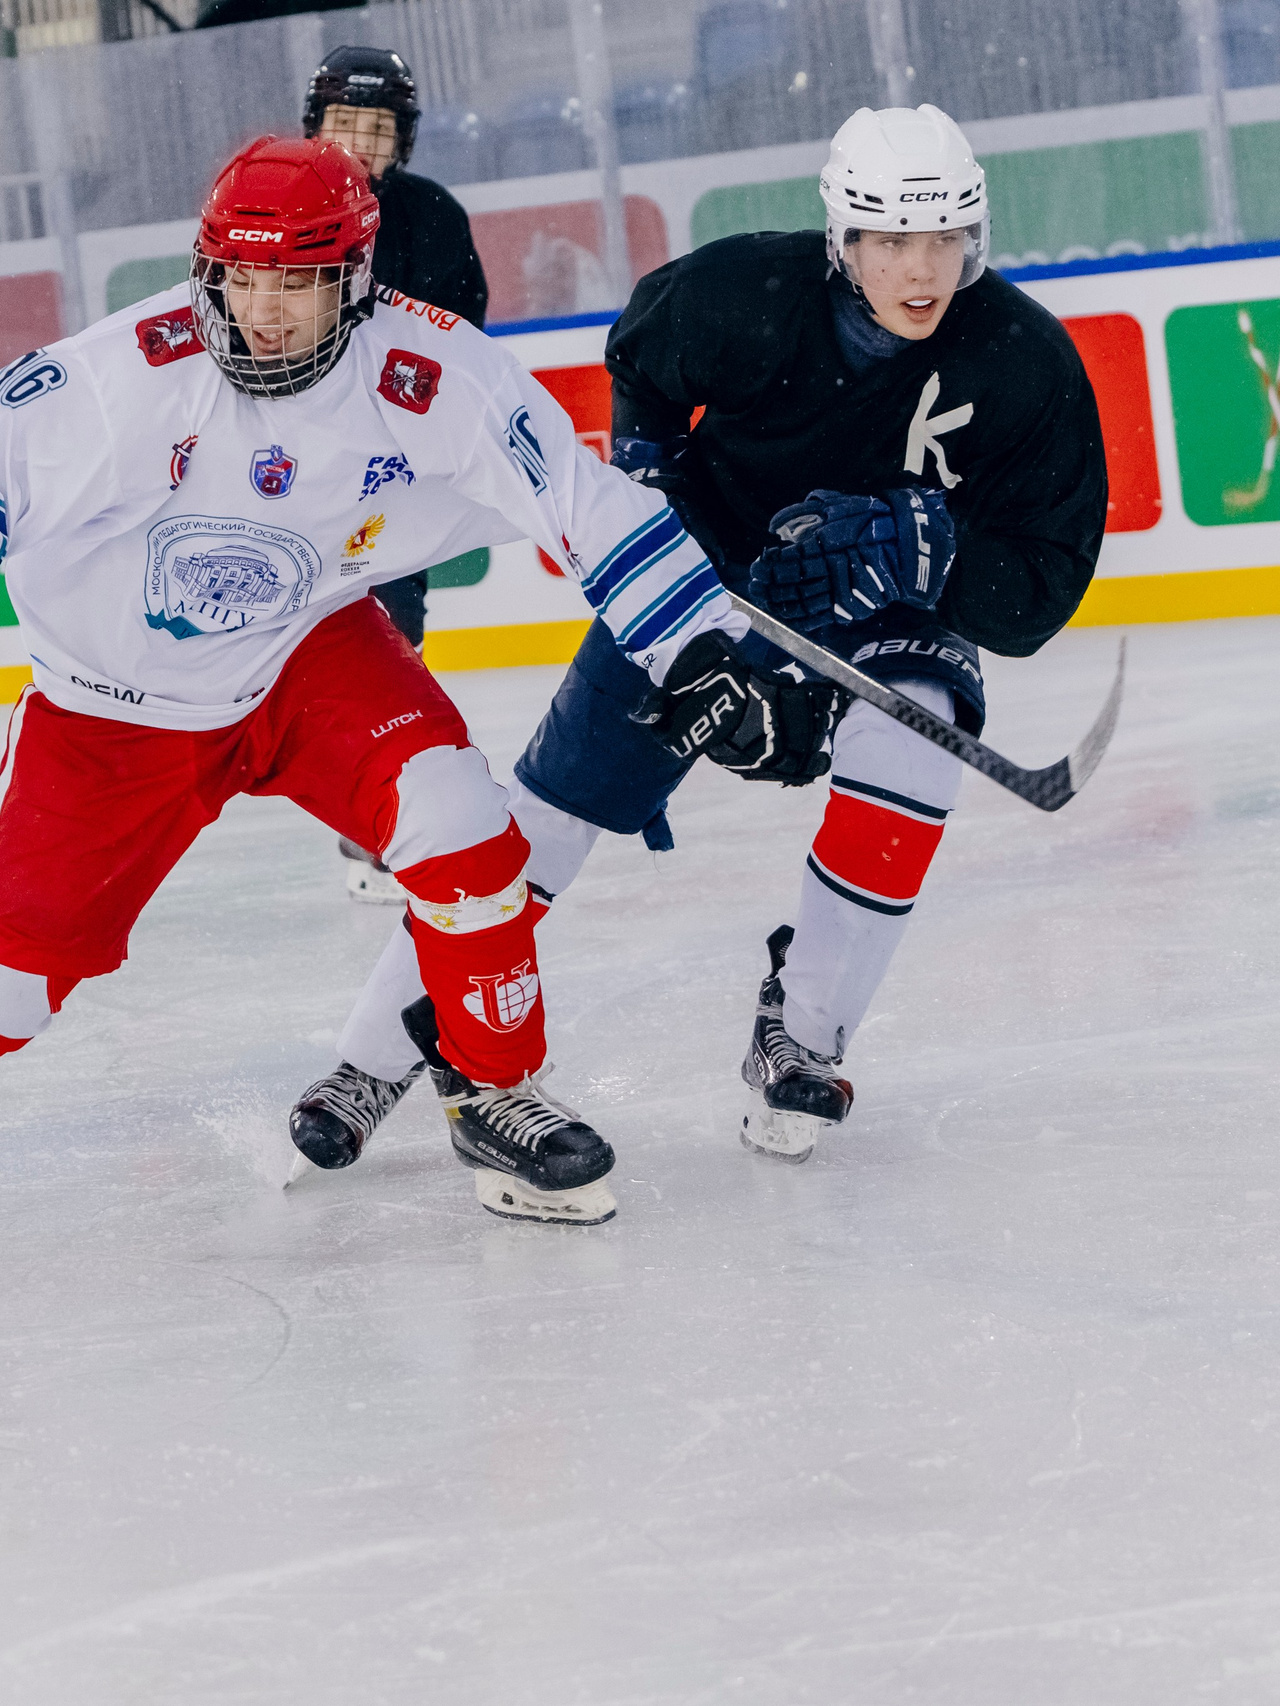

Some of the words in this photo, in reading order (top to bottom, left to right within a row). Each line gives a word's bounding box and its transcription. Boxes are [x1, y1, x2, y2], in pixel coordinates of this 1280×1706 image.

[899, 191, 949, 203] CCM
[228, 228, 284, 243] CCM
[904, 371, 974, 489] K
[158, 520, 246, 543] ПЕДАГОГИЧЕСКИЙ
[370, 709, 424, 738] LUTCH
[477, 1141, 518, 1169] BAUER
